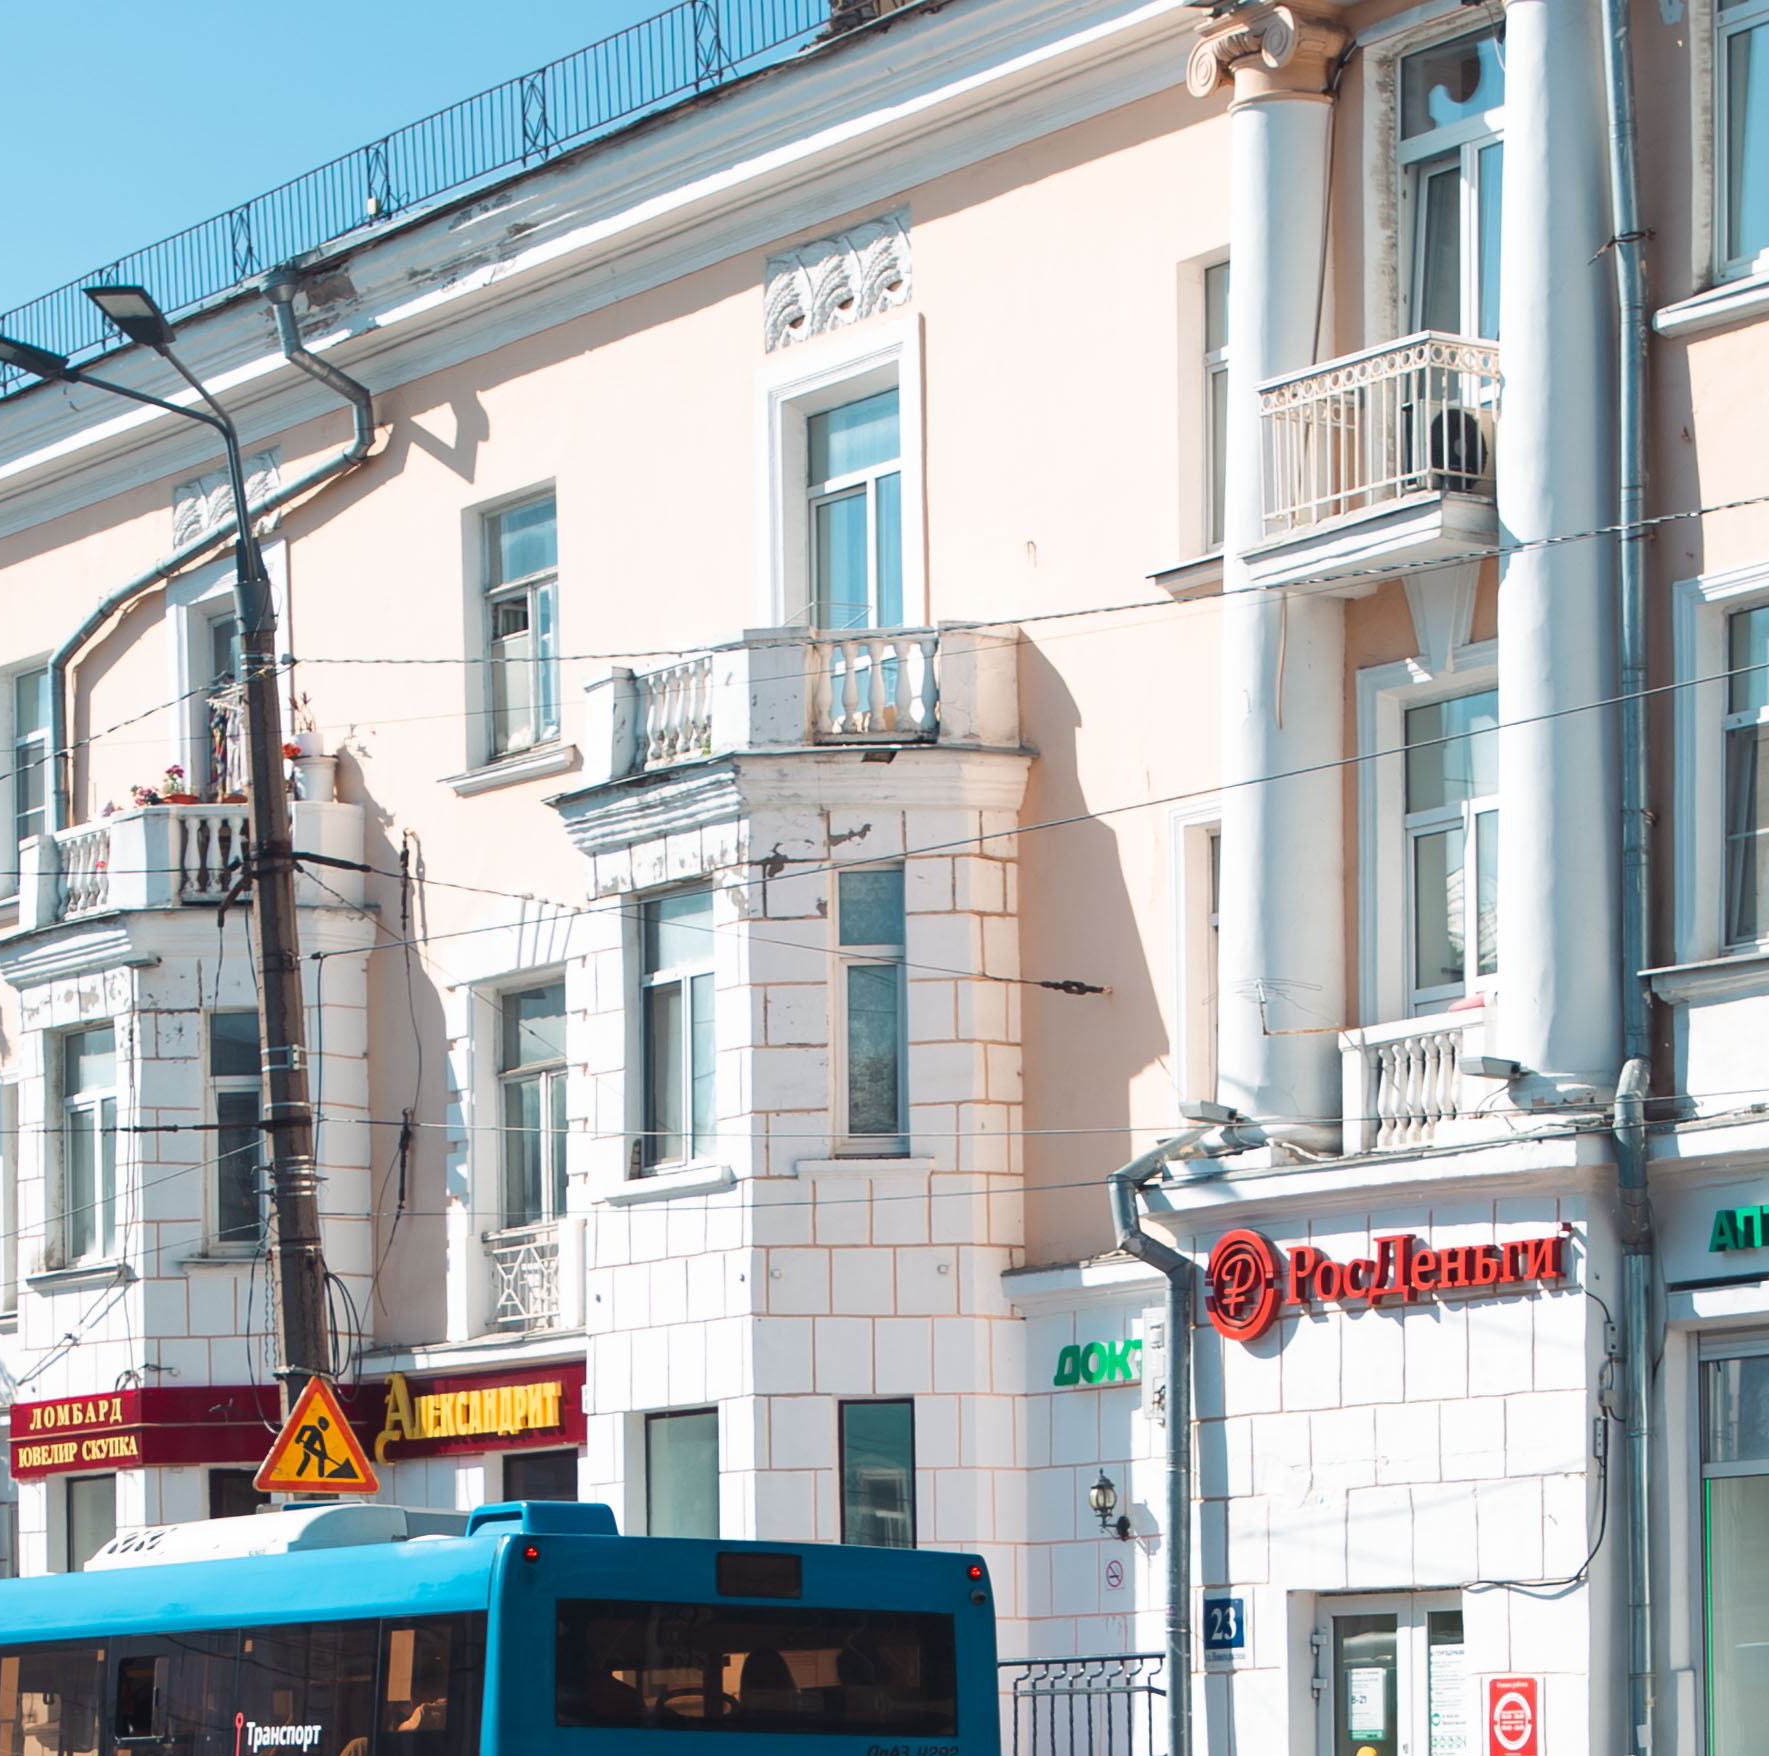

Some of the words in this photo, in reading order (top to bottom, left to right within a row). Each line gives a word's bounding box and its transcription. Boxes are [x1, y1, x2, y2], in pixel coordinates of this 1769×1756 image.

[1285, 1234, 1566, 1305] РосДеньги
[29, 1397, 123, 1431] ЛОМБАРД
[18, 1441, 78, 1468] ЮВЕЛИР
[81, 1435, 138, 1461] СКУПКА
[1211, 1606, 1237, 1640] 23
[246, 1721, 322, 1753] Транспорт
